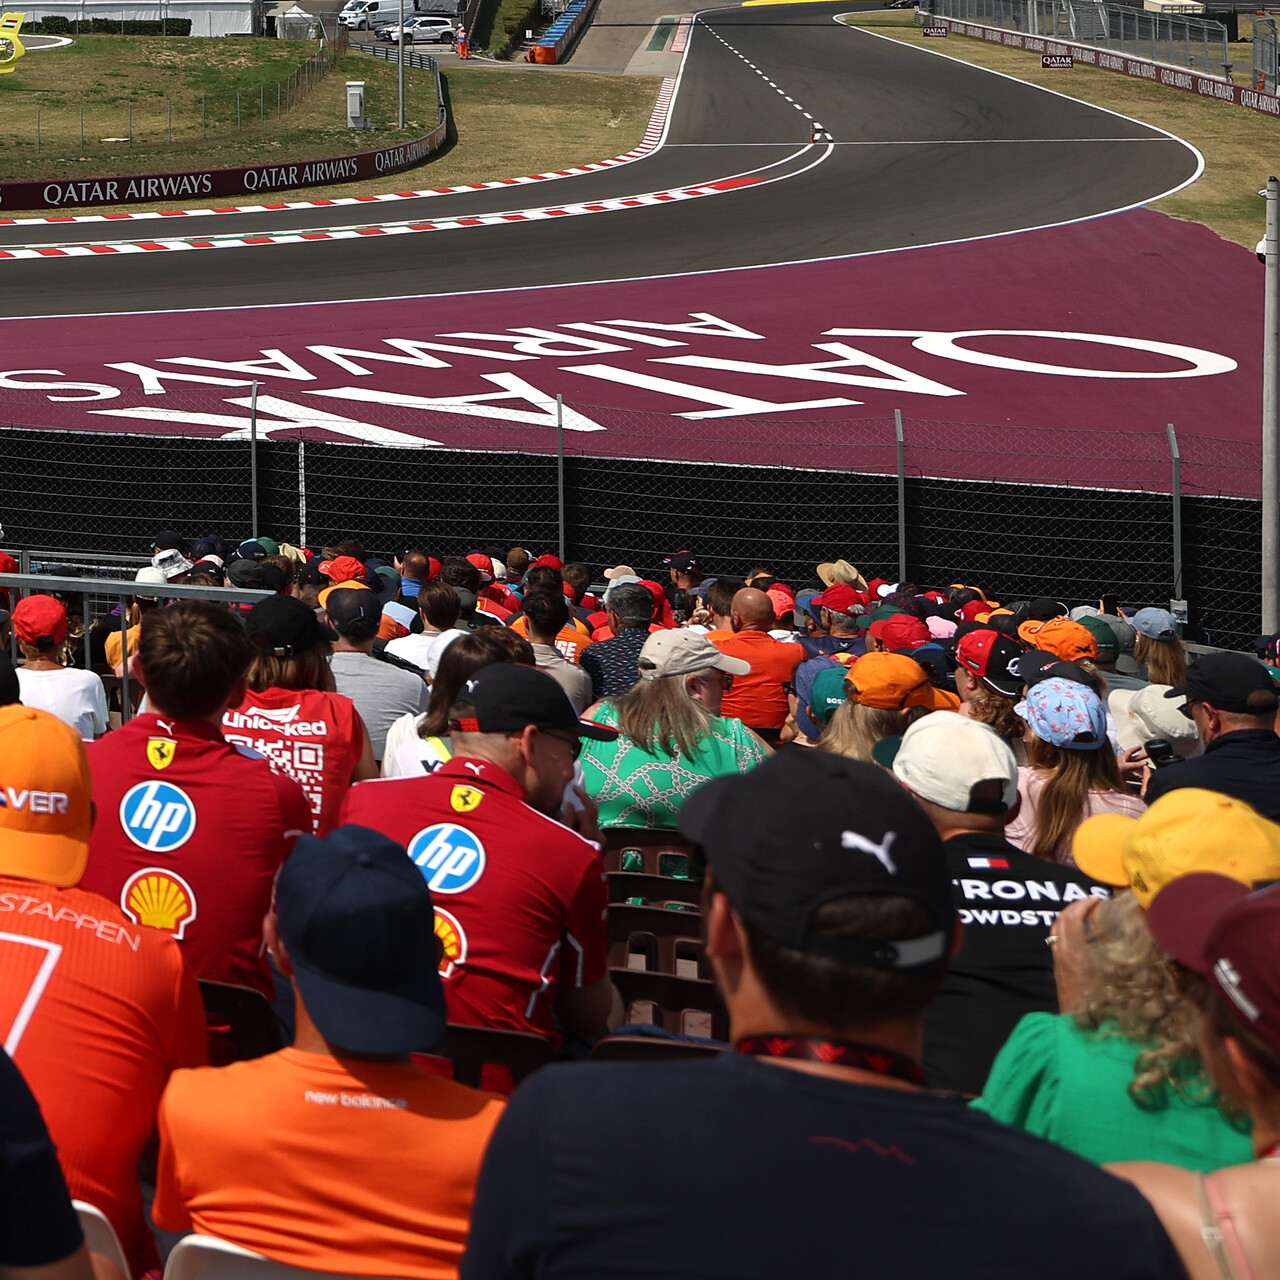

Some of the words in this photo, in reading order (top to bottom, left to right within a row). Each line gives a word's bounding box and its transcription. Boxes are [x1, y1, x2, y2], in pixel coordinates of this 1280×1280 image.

[1042, 56, 1072, 64] QATAR
[1197, 79, 1214, 96] QATAR
[1213, 83, 1235, 101] AIRWAYS
[1240, 90, 1257, 108] QATAR
[1257, 95, 1280, 115] AIRWAYS
[374, 147, 405, 172] QATAR
[243, 166, 298, 190] QATAR
[301, 158, 358, 183] AIRWAYS
[43, 181, 119, 205] QATAR
[124, 174, 212, 199] AIRWAYS
[6, 786, 69, 815] VER
[129, 781, 187, 851] hp
[414, 827, 478, 888] hp
[952, 878, 1111, 902] RONAS
[304, 1090, 339, 1105] new
